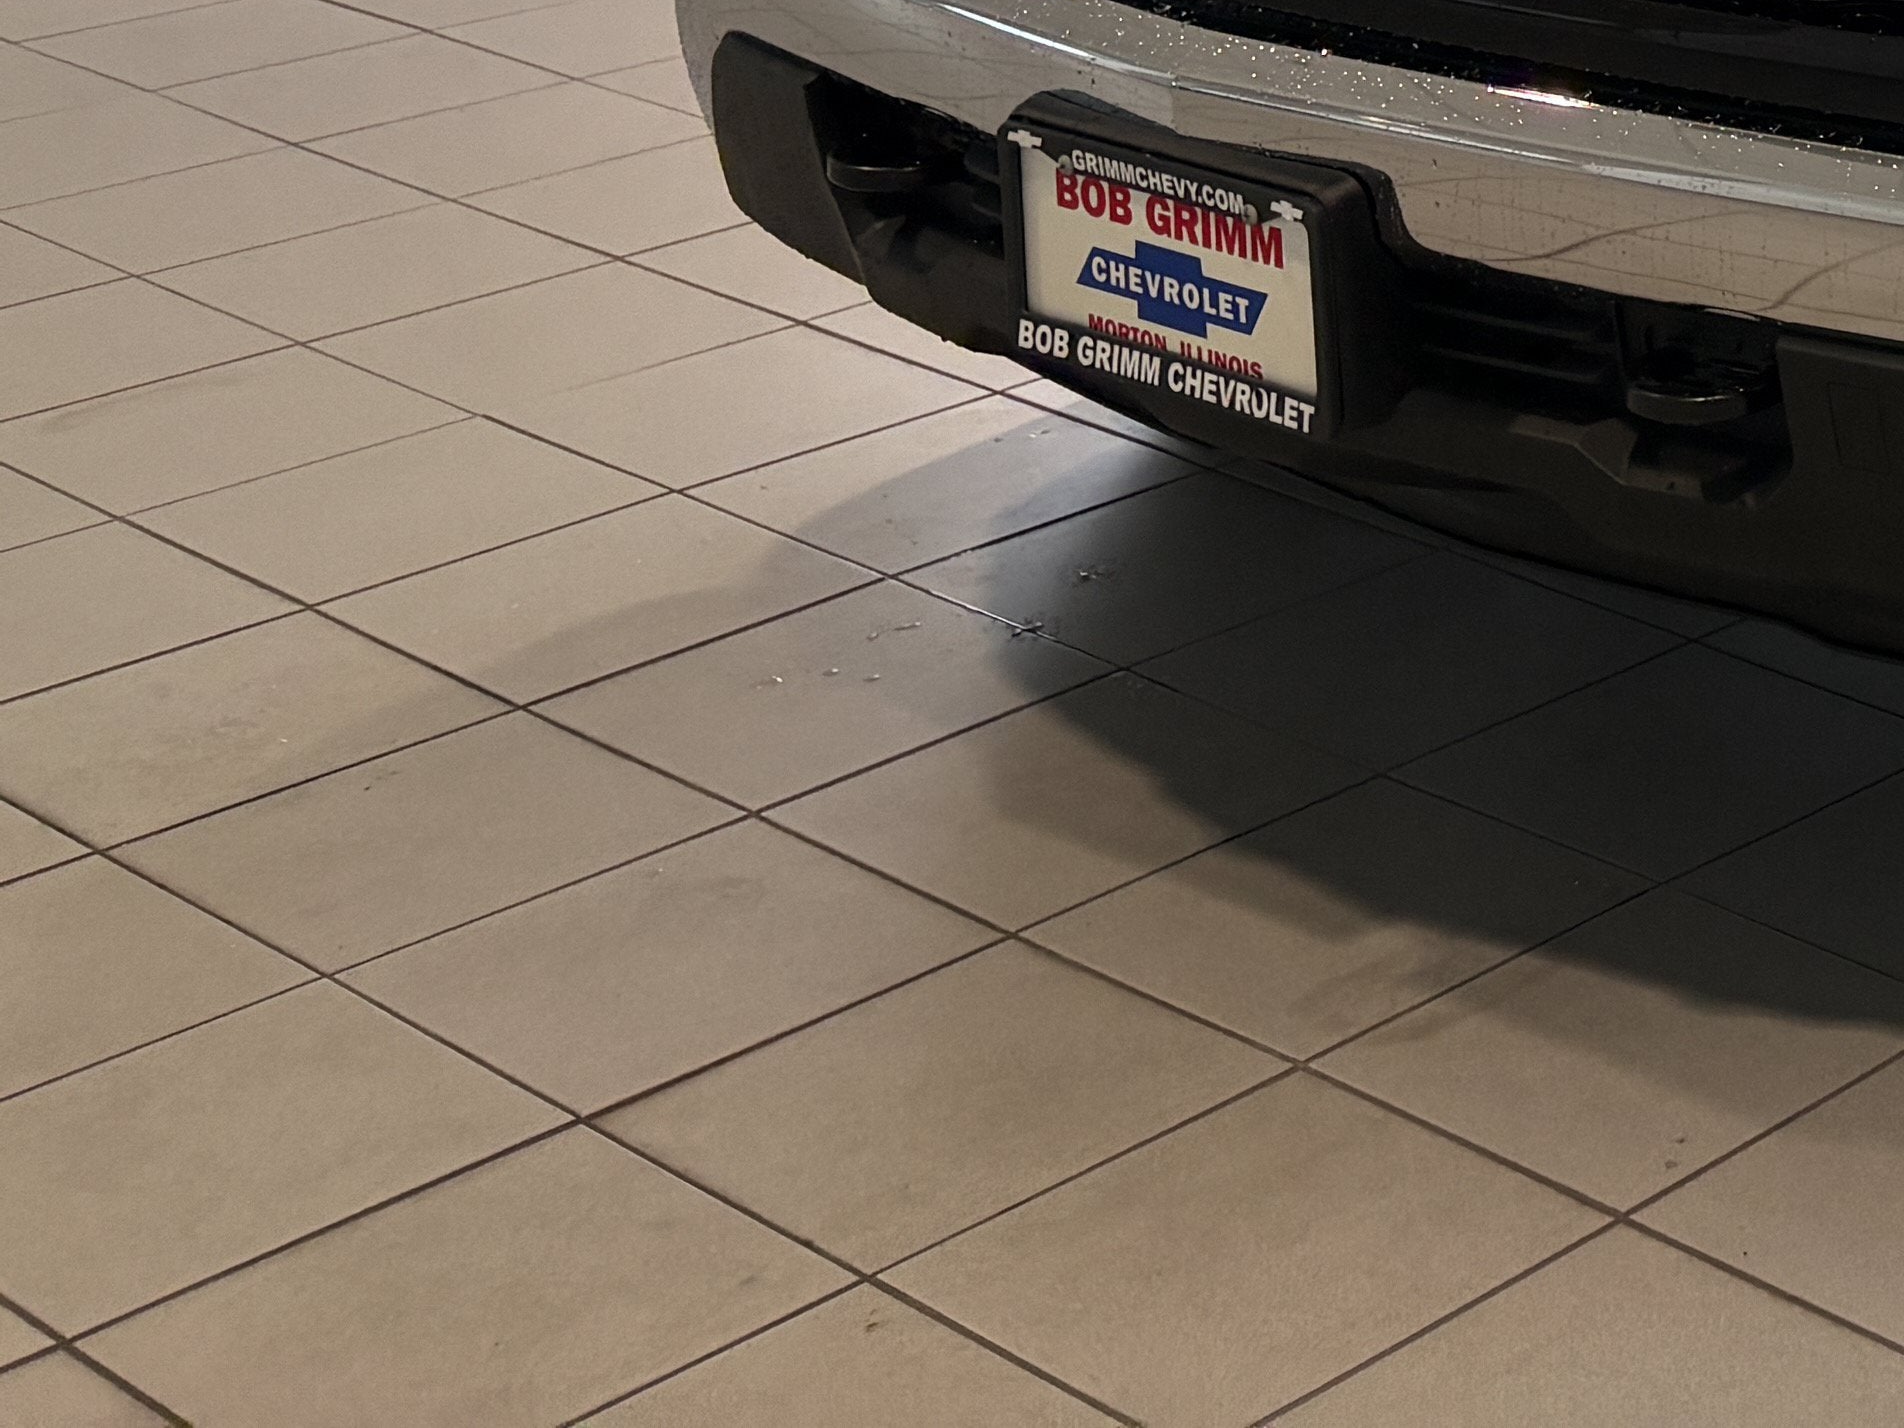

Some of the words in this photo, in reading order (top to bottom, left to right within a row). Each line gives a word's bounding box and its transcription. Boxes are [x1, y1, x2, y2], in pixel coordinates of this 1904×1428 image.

[1071, 149, 1245, 215] GRIMMCHEVY.COM
[1056, 167, 1133, 226] BOB
[1145, 194, 1285, 270] GRIMM
[1091, 256, 1250, 324] CHEVROLET
[1018, 318, 1070, 359] BOB
[1077, 335, 1161, 387] GRIMM
[1167, 362, 1315, 433] CHEVROLET
[1088, 313, 1167, 352] MORTON
[1180, 341, 1264, 380] ILLINOIS
